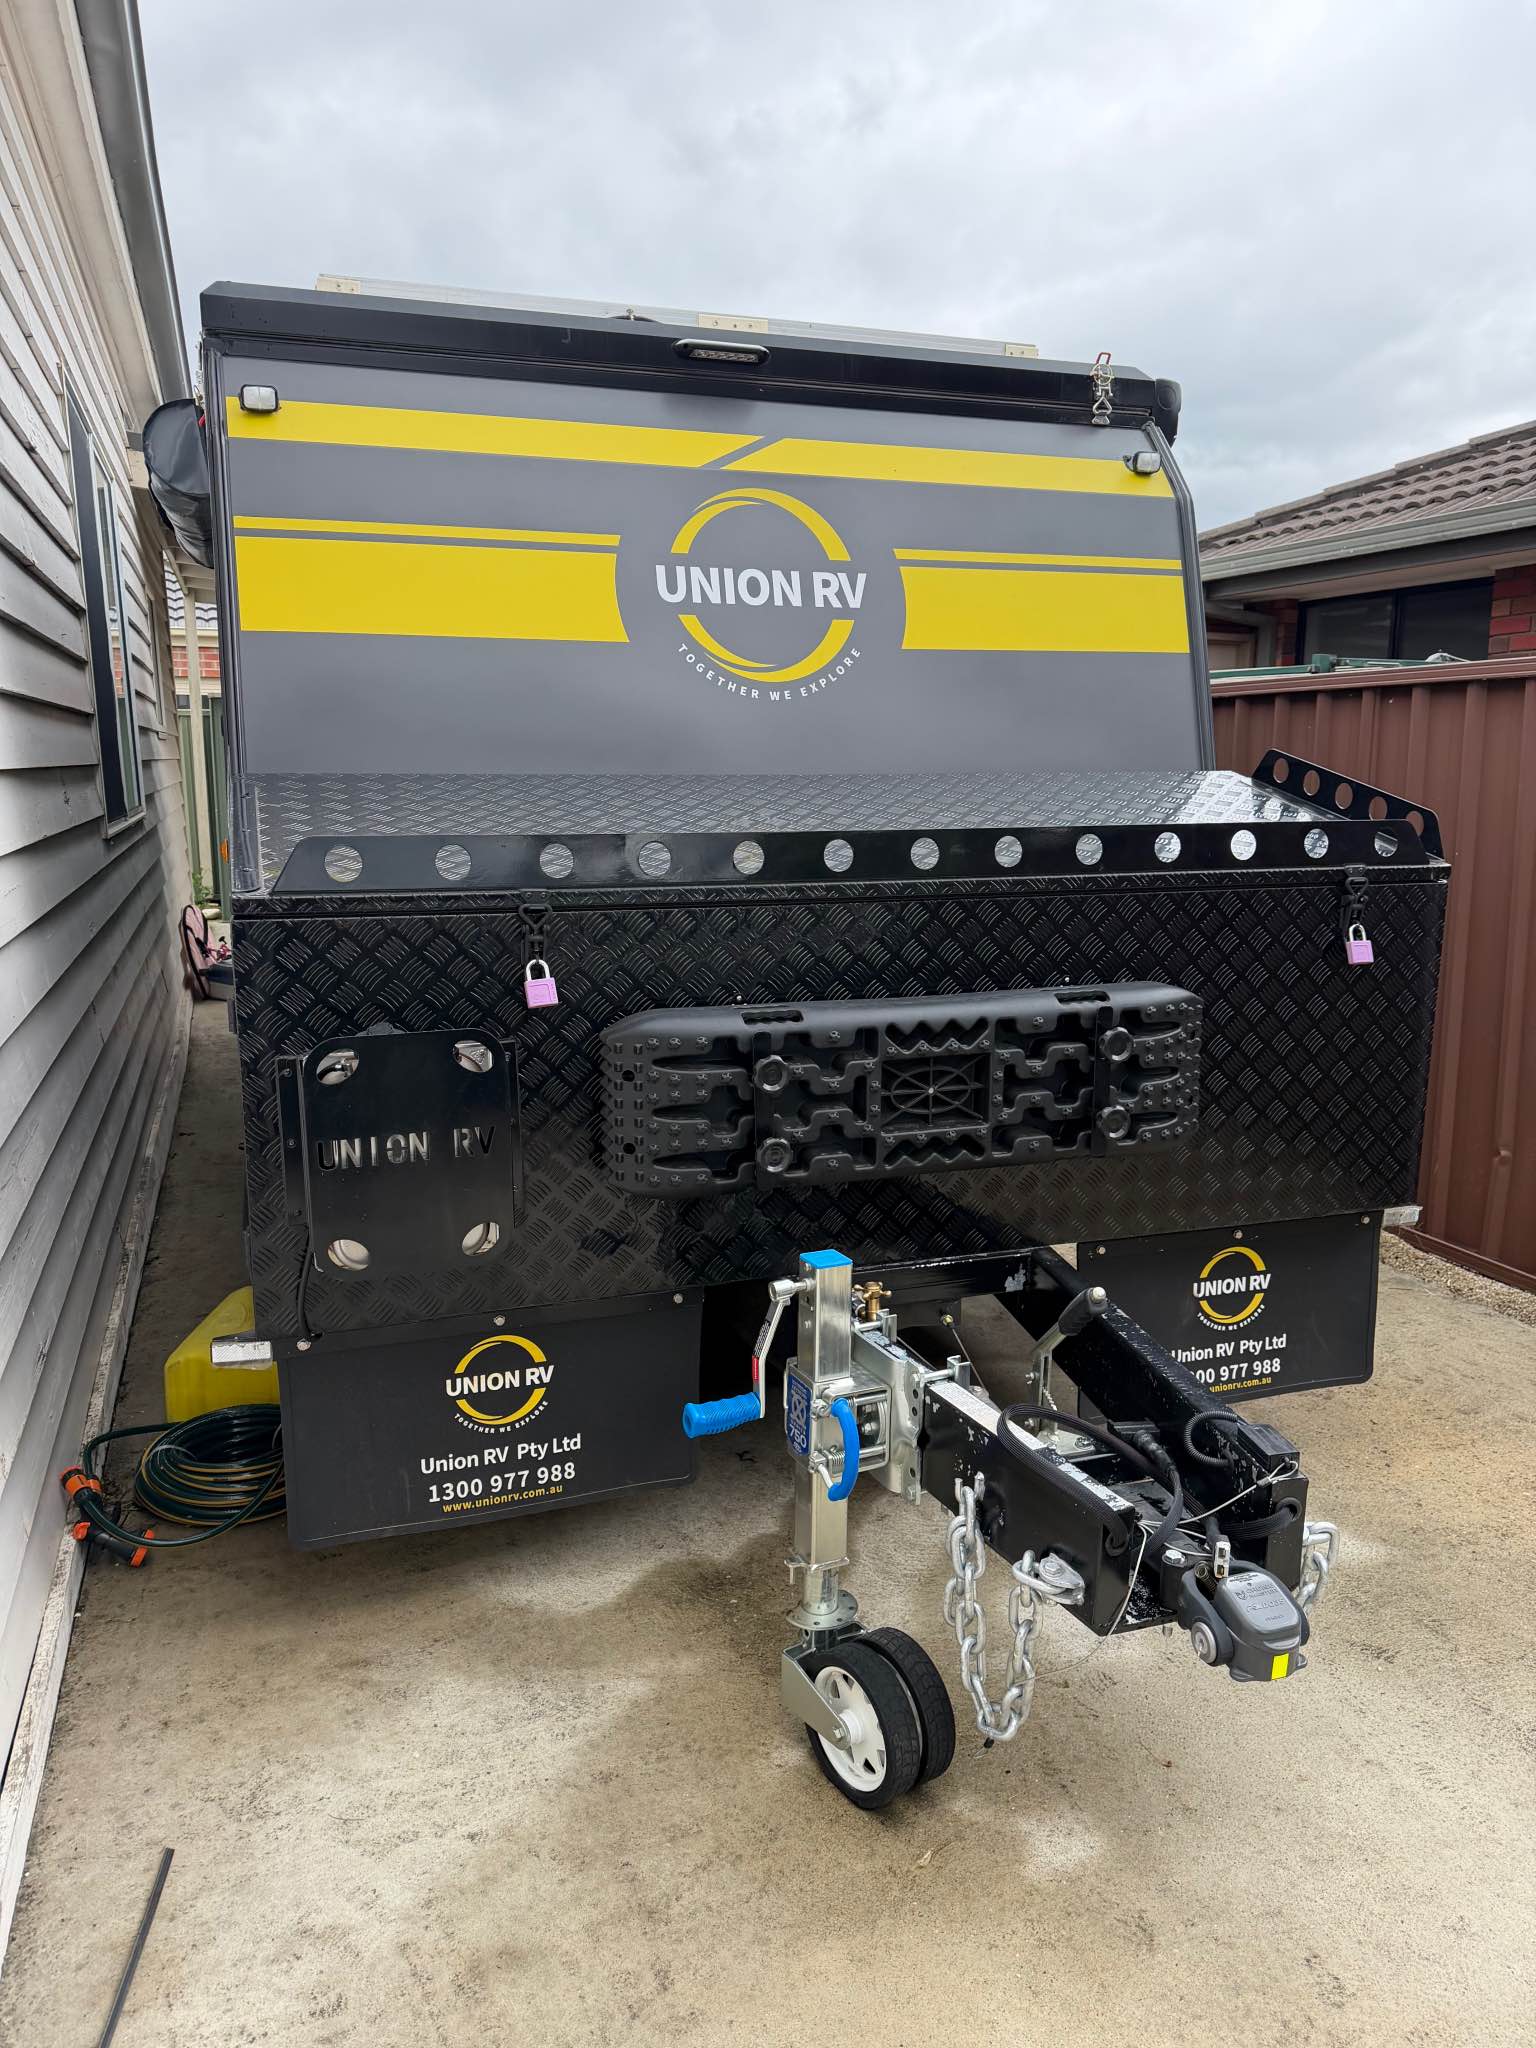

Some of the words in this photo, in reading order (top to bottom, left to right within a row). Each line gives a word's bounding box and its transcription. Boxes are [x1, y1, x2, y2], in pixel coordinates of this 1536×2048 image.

[655, 564, 803, 607] UNION
[812, 571, 867, 609] RV
[678, 643, 760, 699] TOGETHER
[769, 690, 792, 701] WE
[801, 647, 861, 697] EXPLORE
[316, 1131, 431, 1171] UNION
[453, 1126, 495, 1158] RV
[1193, 1276, 1247, 1298] UNION
[1249, 1273, 1271, 1291] RV
[1171, 1346, 1213, 1363] Union
[1216, 1341, 1235, 1358] RV
[1240, 1339, 1263, 1356] Pty
[1265, 1333, 1287, 1350] Ltd
[445, 1370, 520, 1397] UNION
[525, 1365, 555, 1386] RV
[1190, 1368, 1215, 1384] 00
[1220, 1362, 1248, 1381] 977
[1252, 1357, 1281, 1376] 988
[1209, 1377, 1272, 1393] unionrv.com.au
[454, 1413, 495, 1434] TOGETHER
[499, 1425, 511, 1433] WE
[515, 1400, 549, 1429] EXPLORE
[789, 1423, 807, 1448] 750
[420, 1454, 479, 1474] Union
[483, 1446, 509, 1465] RV
[517, 1441, 548, 1460] Pty
[552, 1433, 582, 1454] Ltd
[428, 1478, 483, 1503] 1300
[490, 1469, 530, 1493] 977
[536, 1462, 576, 1484] 988
[442, 1484, 563, 1513] www.unionrv.com.au
